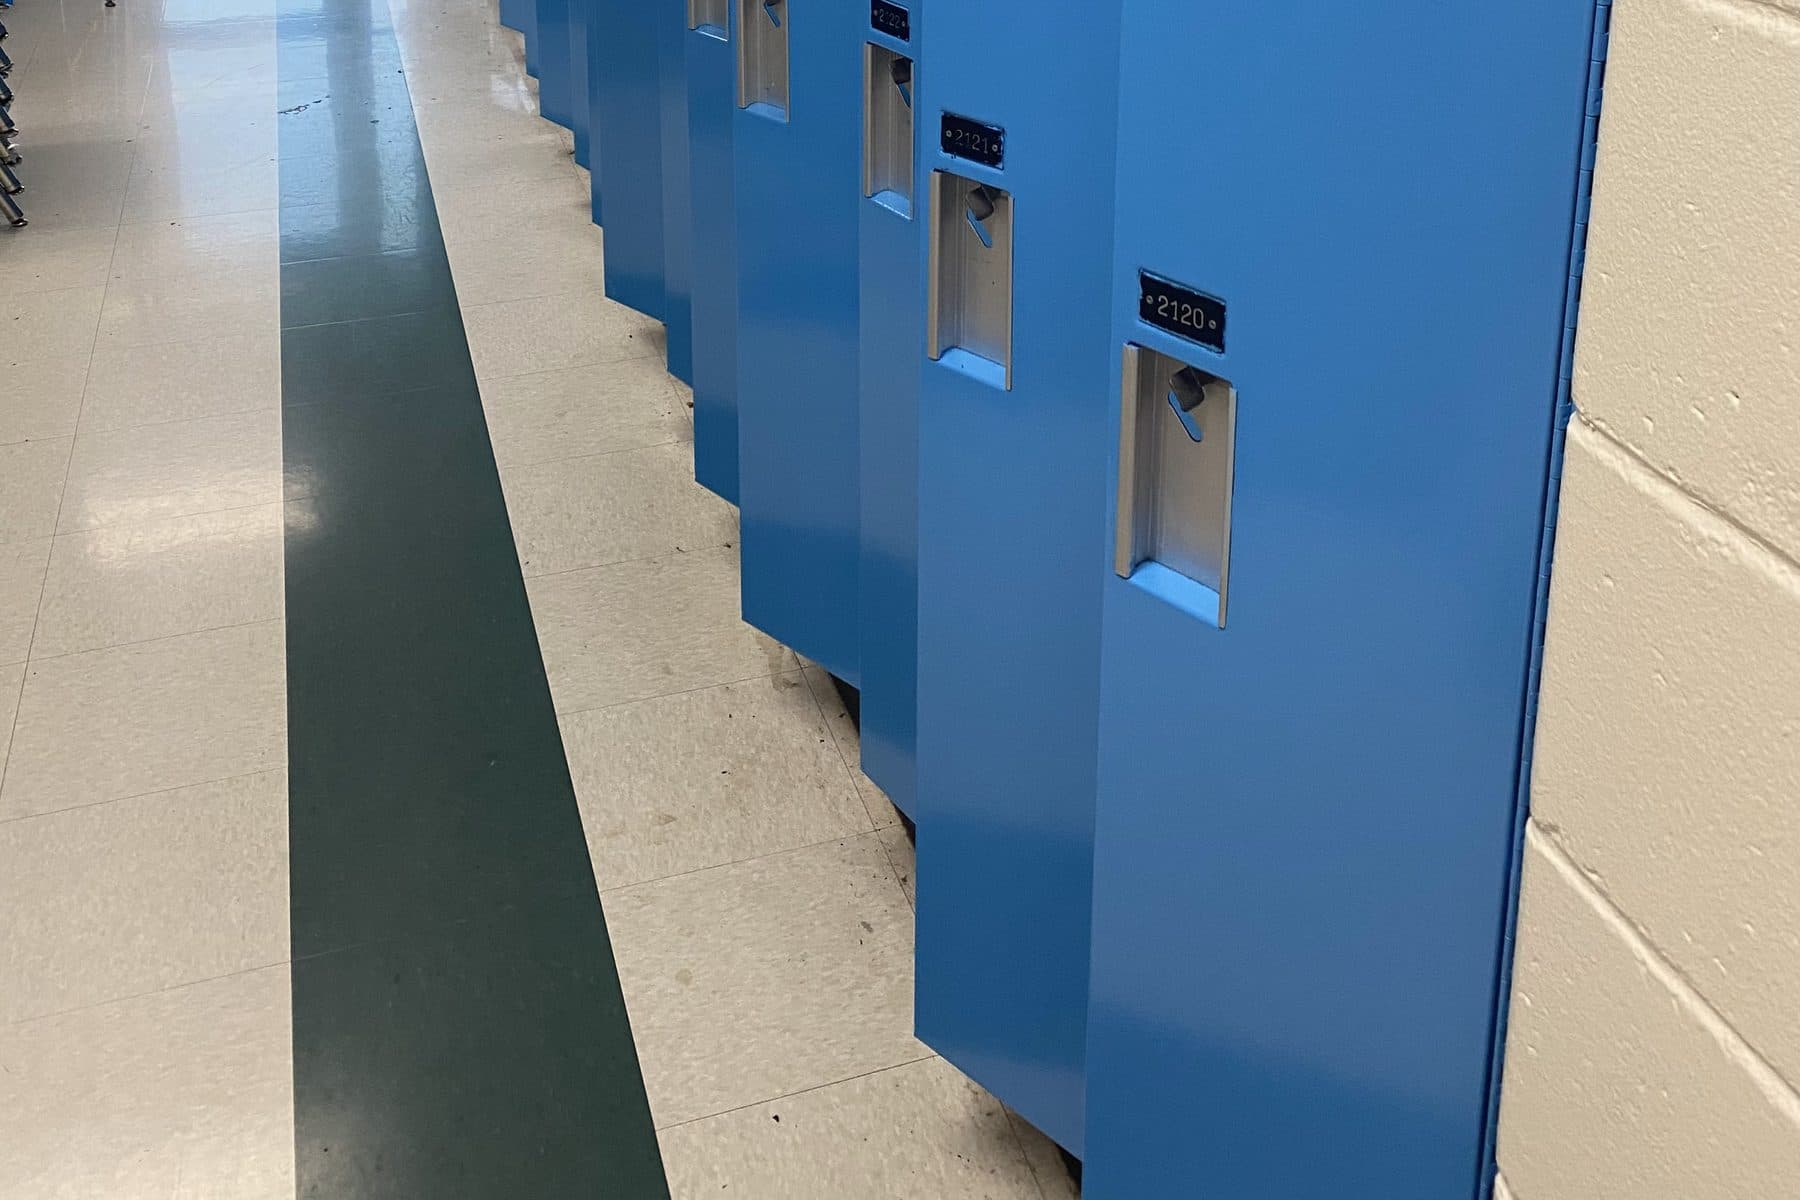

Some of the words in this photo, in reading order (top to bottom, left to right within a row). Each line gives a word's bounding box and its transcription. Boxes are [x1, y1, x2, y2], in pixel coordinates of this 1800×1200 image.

[879, 8, 901, 29] 2122
[955, 129, 988, 155] 2121
[1157, 295, 1204, 329] 2120
